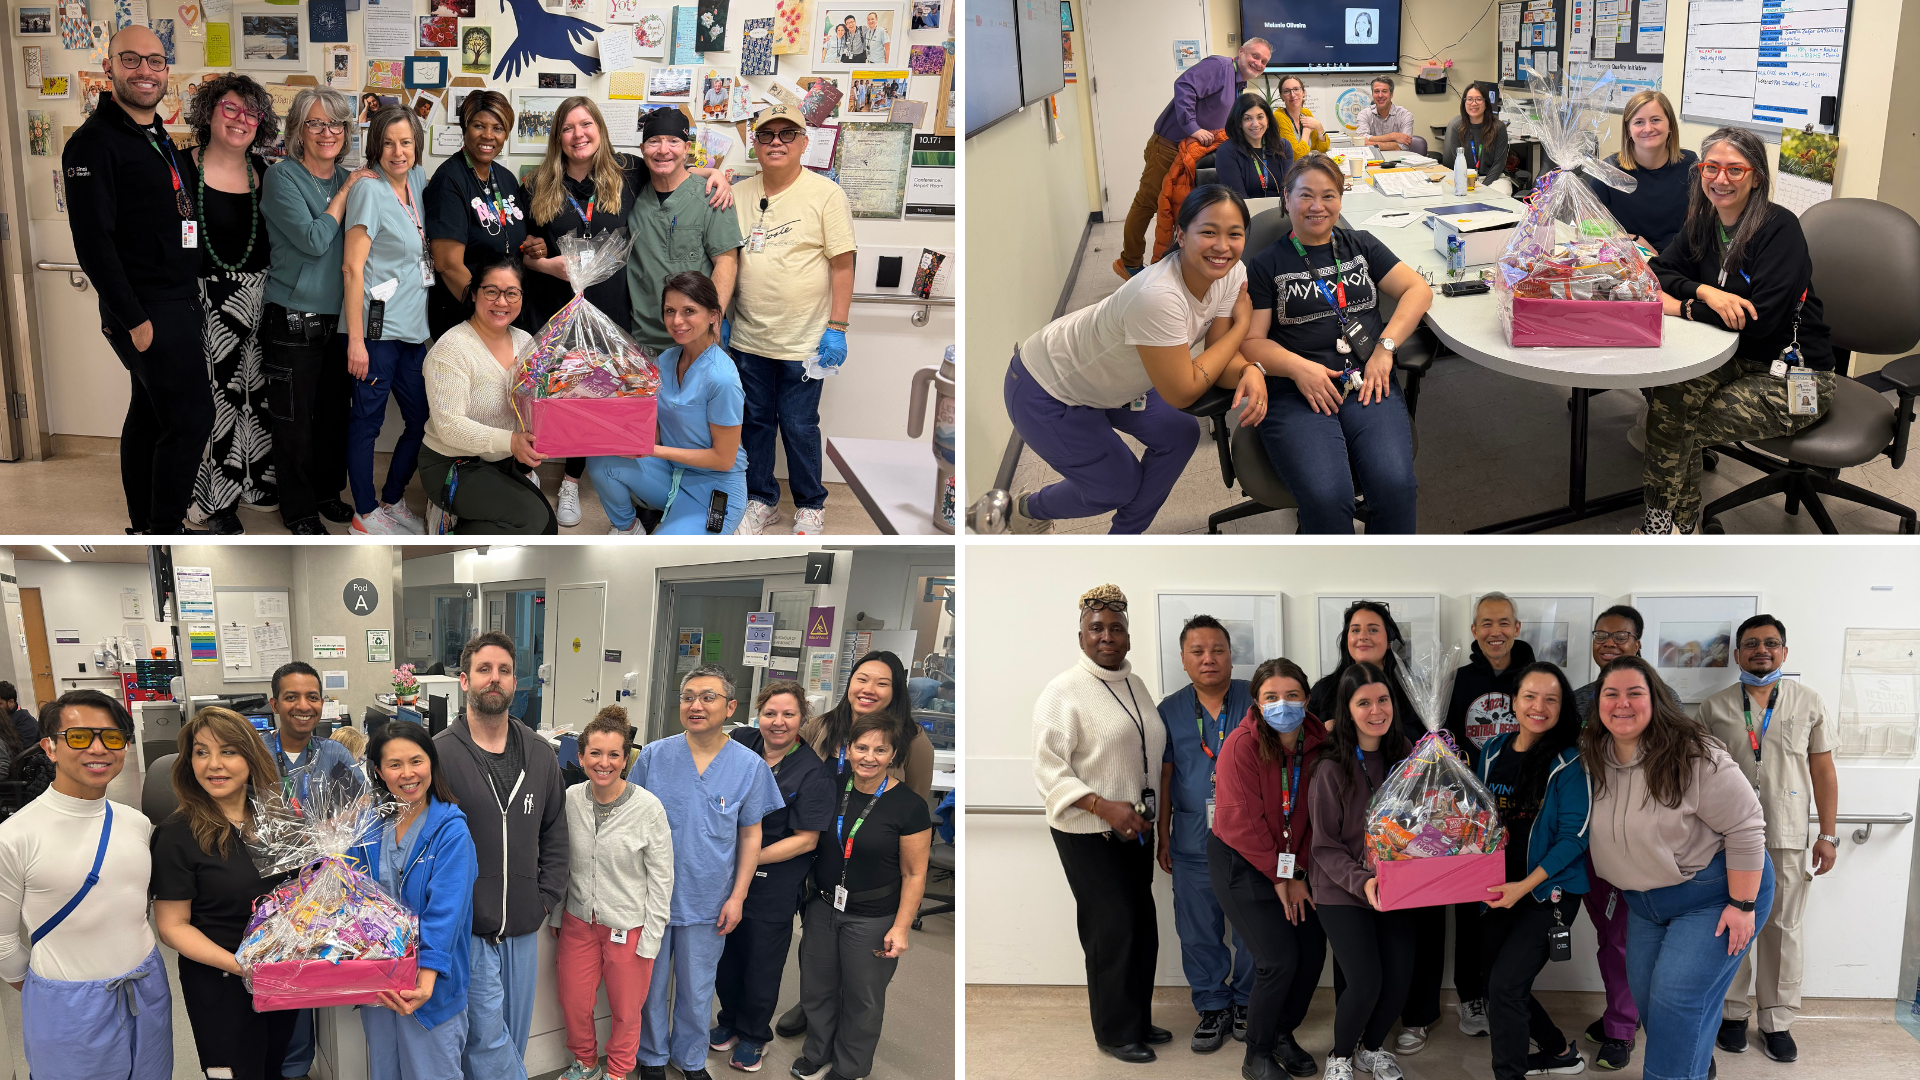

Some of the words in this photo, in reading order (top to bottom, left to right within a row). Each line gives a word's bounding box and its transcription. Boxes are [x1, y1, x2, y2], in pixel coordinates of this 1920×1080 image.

[1612, 63, 1626, 71] Quality
[919, 136, 942, 144] 10.171
[814, 564, 822, 580] 7
[353, 583, 368, 592] Pod
[466, 589, 472, 598] 6
[354, 594, 369, 611] A
[1466, 723, 1497, 738] CENTRAL
[1415, 840, 1440, 857] Hero
